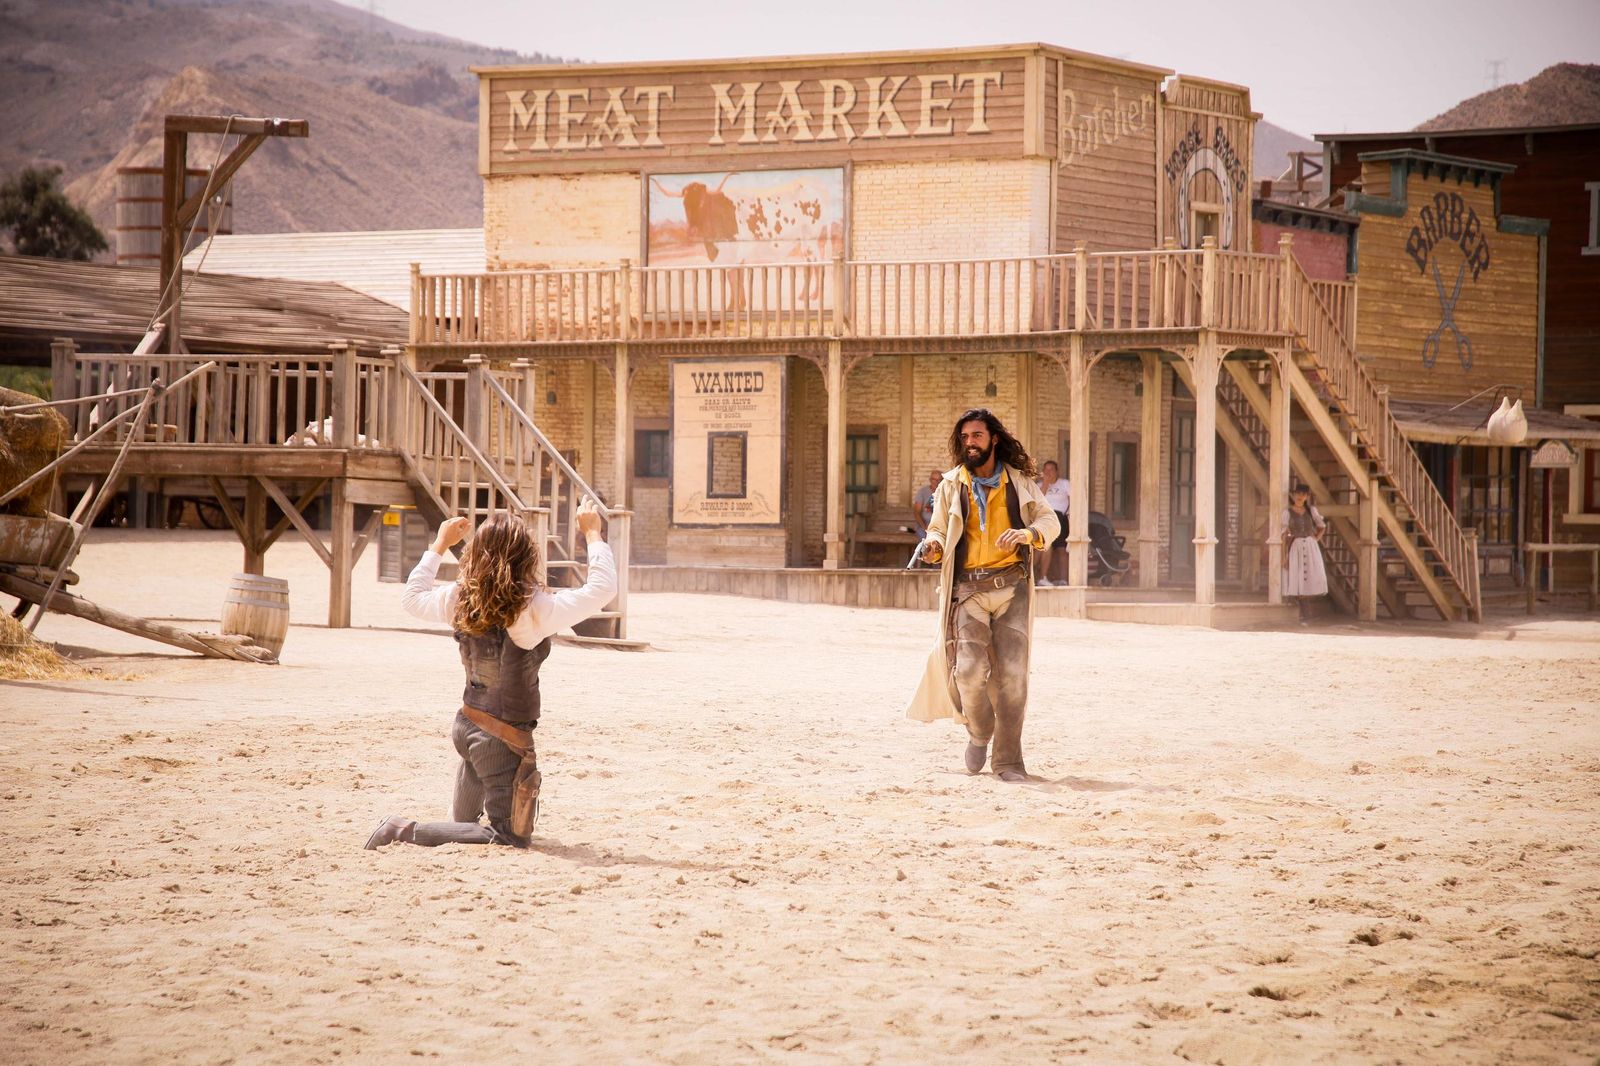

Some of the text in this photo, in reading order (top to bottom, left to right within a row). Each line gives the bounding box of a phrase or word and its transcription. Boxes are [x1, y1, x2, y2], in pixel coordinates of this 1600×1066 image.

[502, 71, 1003, 153] MEAT MARKET
[1060, 86, 1154, 168] Butcher
[1165, 121, 1202, 186] HORSE
[1405, 192, 1490, 283] BARBER
[691, 371, 764, 393] WANTED
[704, 398, 720, 406] DEAD
[732, 397, 751, 405] ALIVE
[700, 502, 728, 511] REWARD
